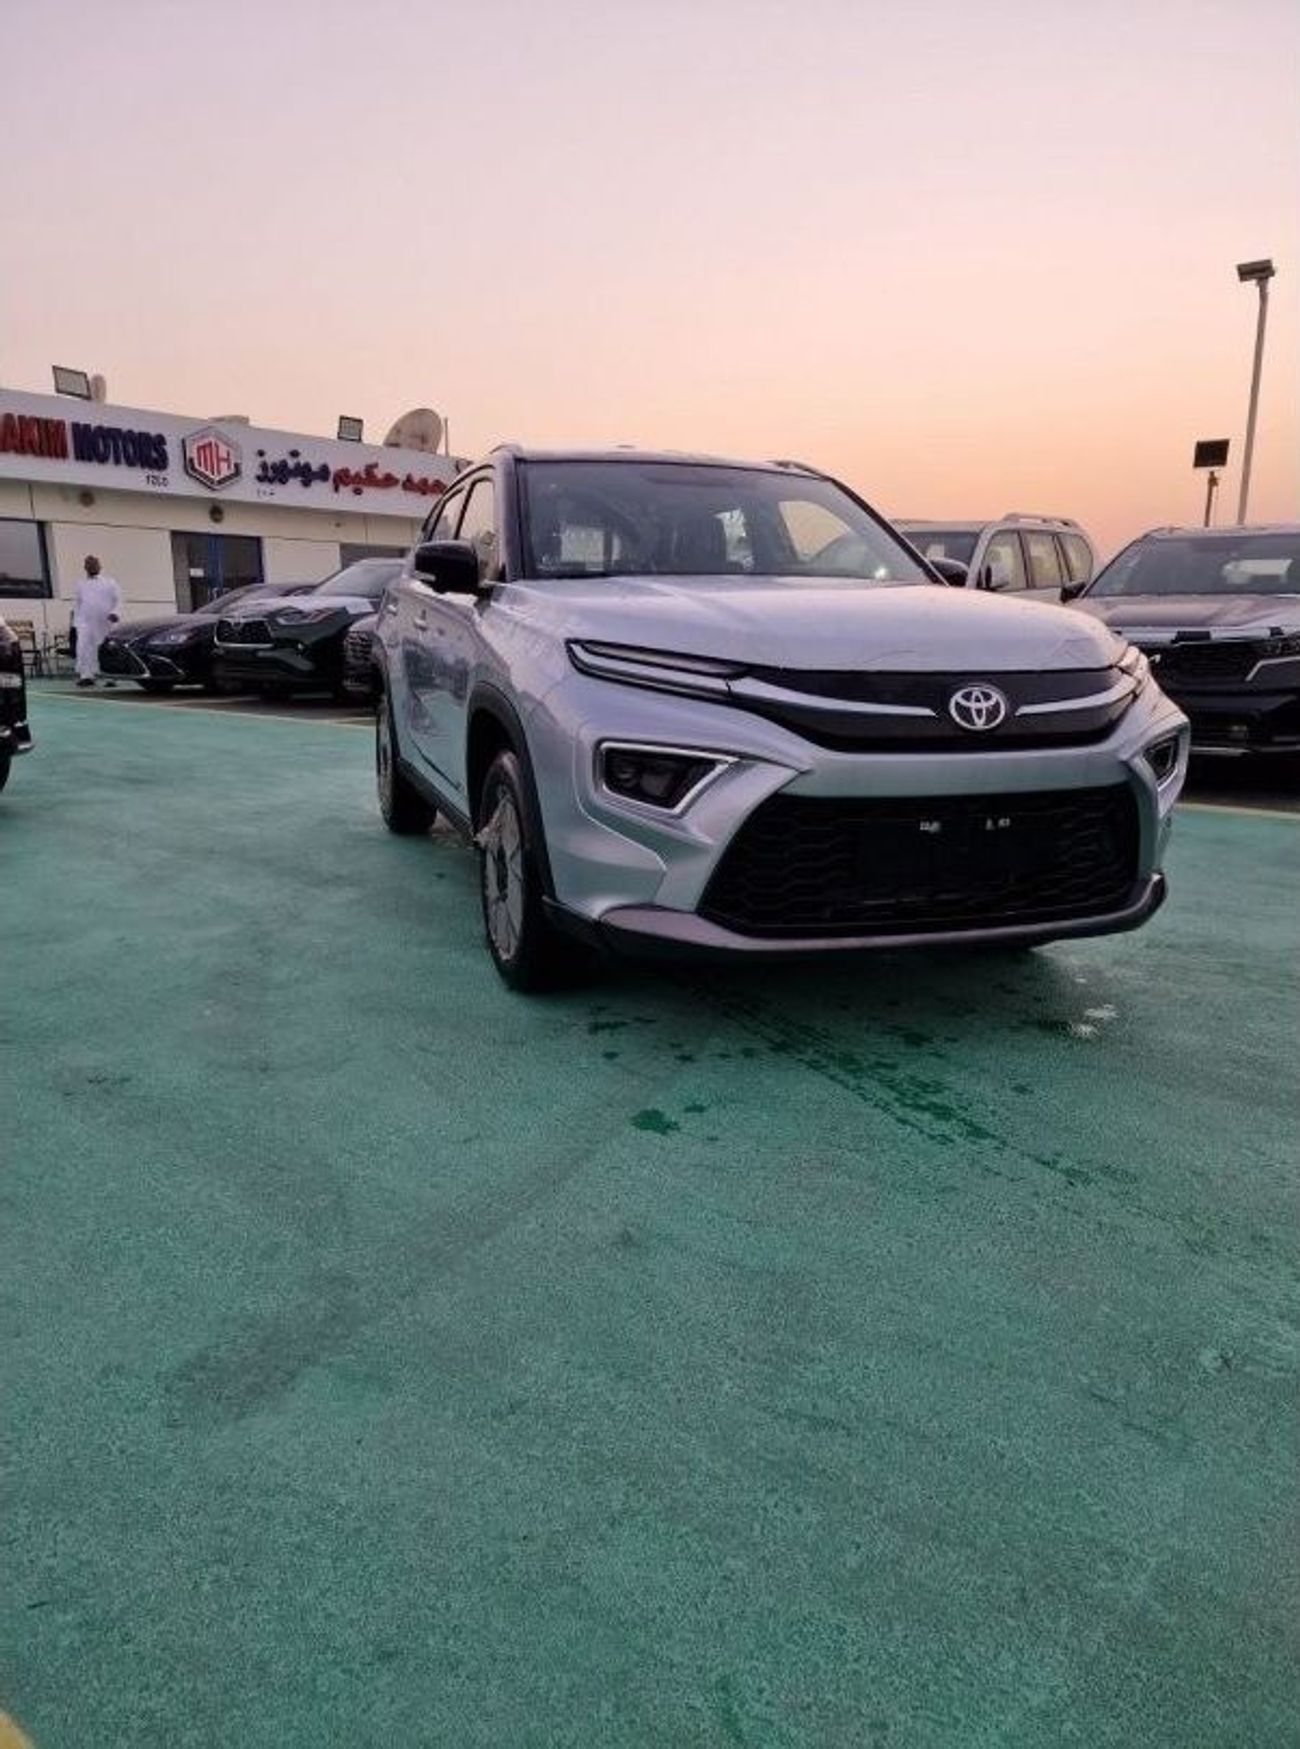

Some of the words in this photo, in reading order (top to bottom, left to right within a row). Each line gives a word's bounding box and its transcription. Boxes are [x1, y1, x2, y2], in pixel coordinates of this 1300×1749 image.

[0, 413, 68, 459] AKIM
[72, 422, 169, 471] MOTORS
[255, 449, 331, 487] موتورز
